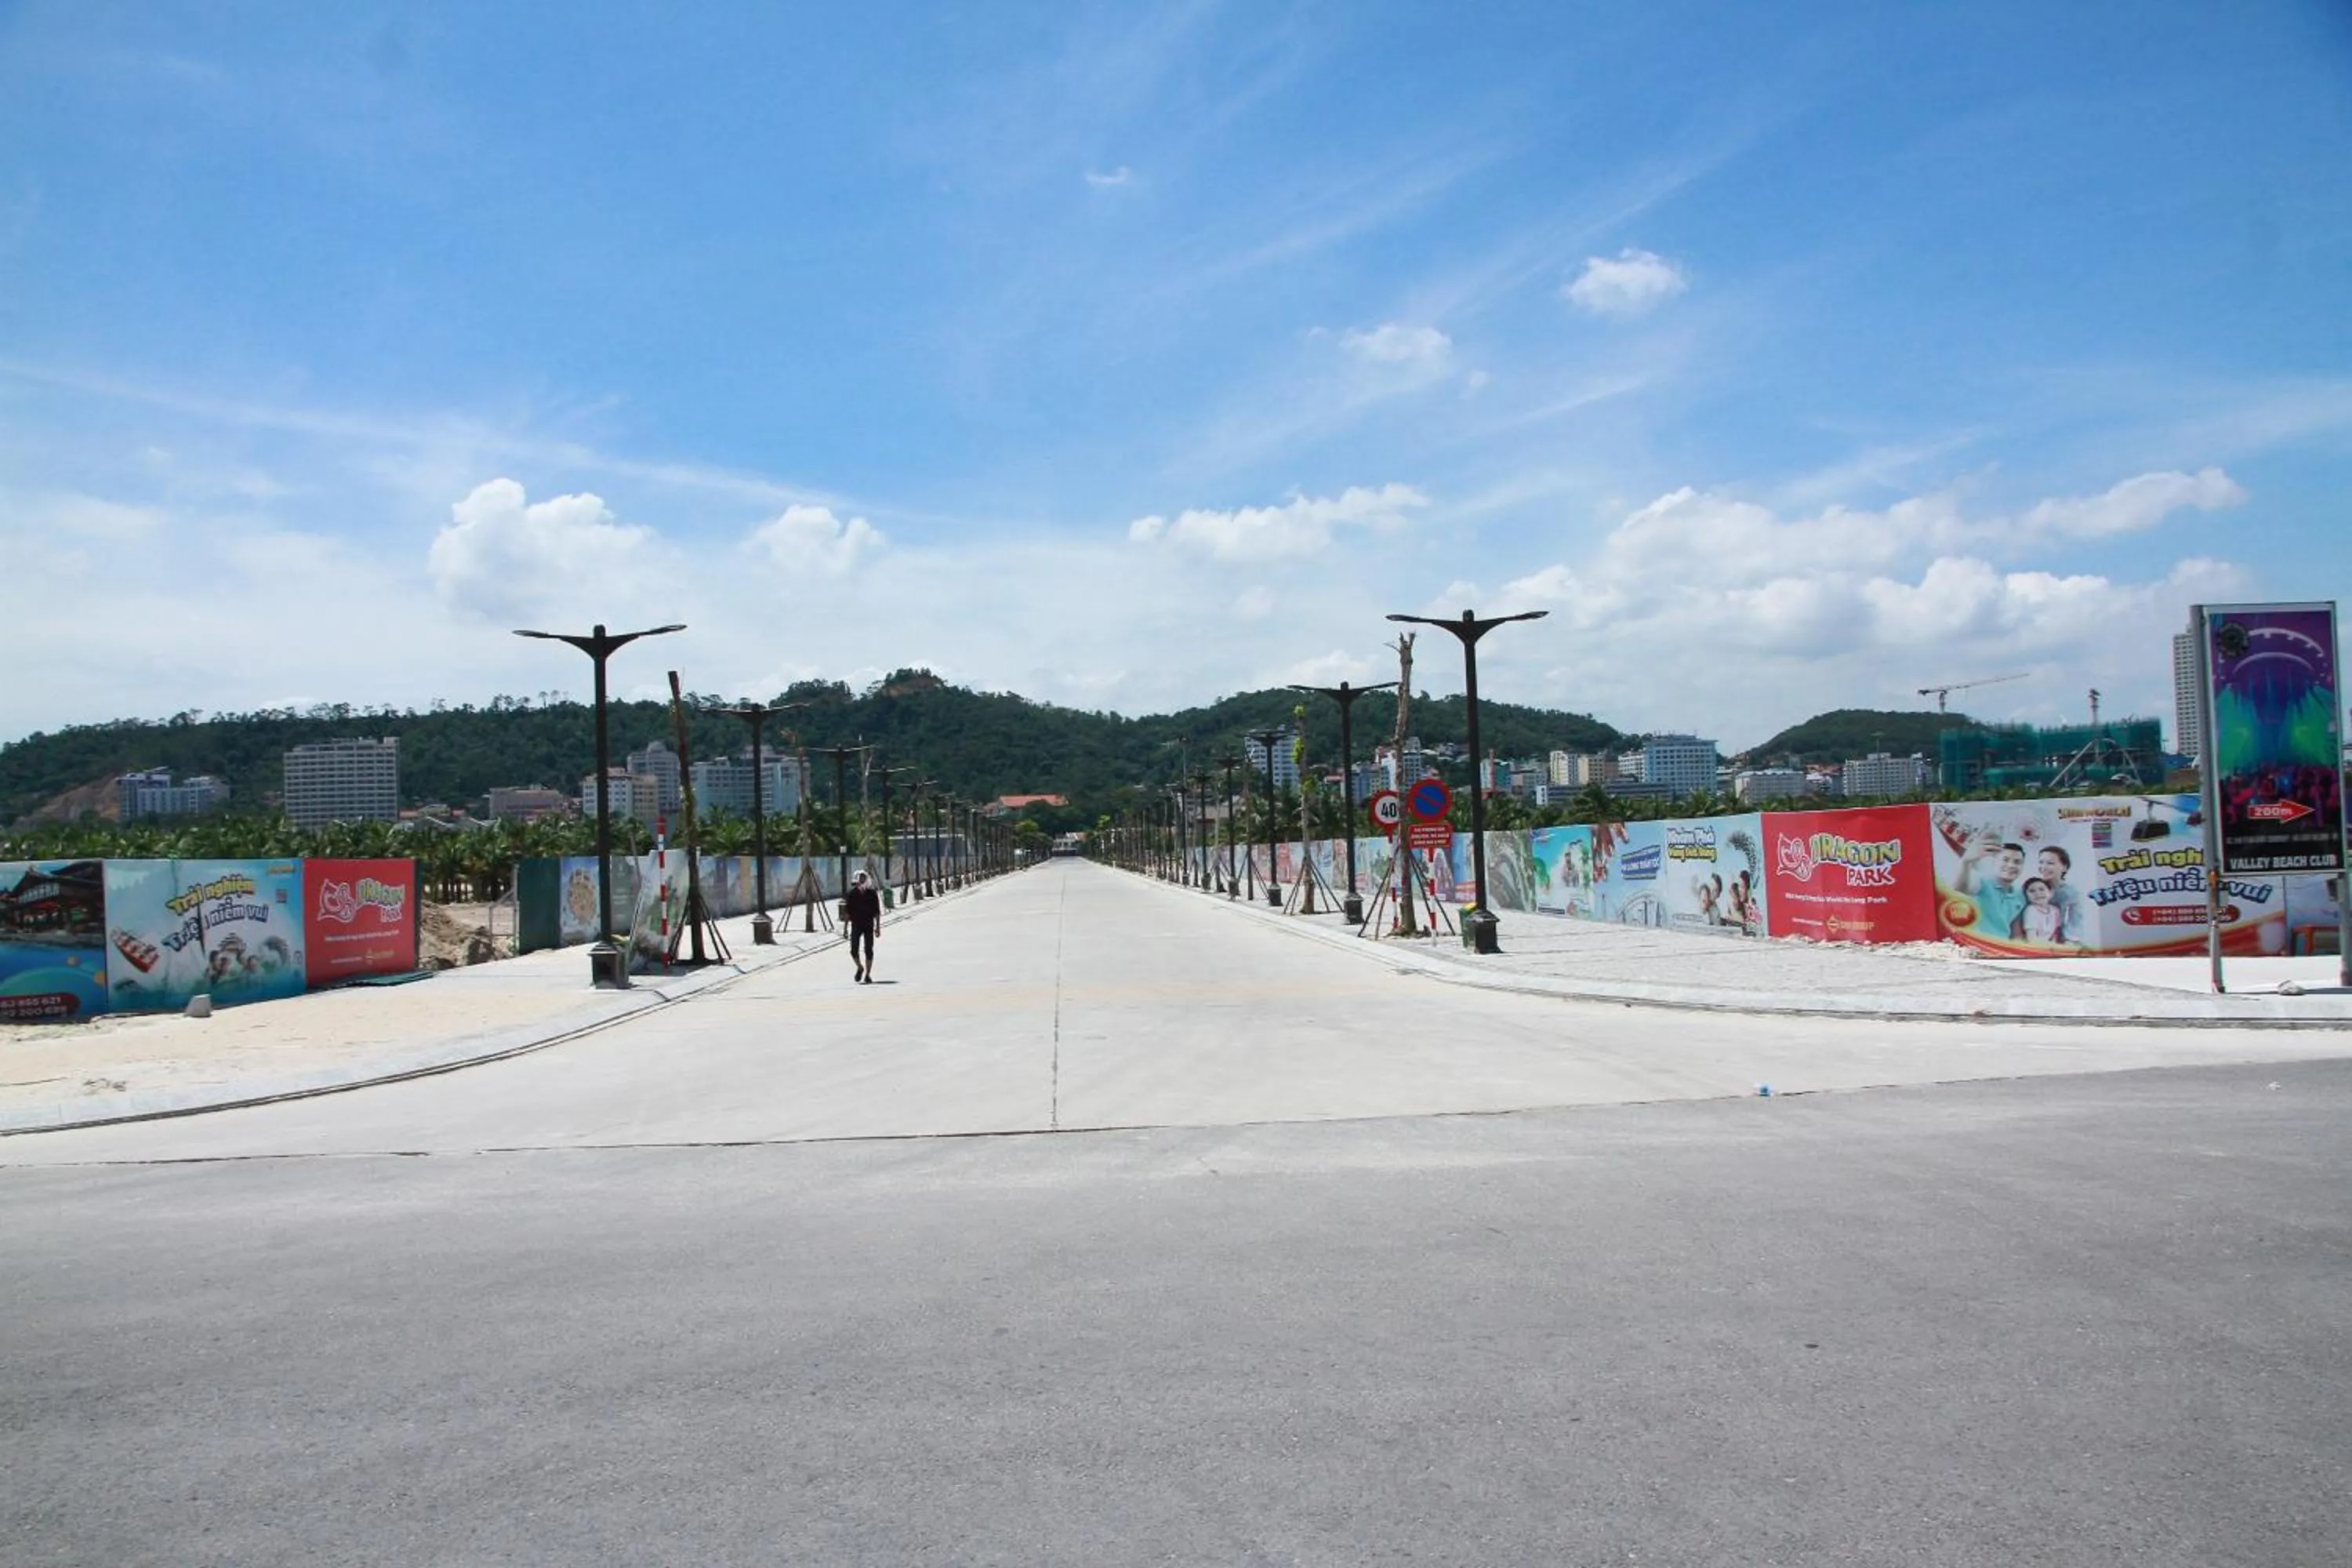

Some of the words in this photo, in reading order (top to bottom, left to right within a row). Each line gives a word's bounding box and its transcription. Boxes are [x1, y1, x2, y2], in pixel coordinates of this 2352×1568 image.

[1381, 802, 1397, 818] 40
[2254, 807, 2293, 817] 200m
[1809, 833, 1901, 868] DRAGON
[2098, 848, 2151, 875] Trải
[2154, 847, 2205, 868] ngh
[2230, 857, 2271, 870] VALLEY
[2272, 855, 2307, 869] BEACH
[2309, 853, 2337, 866] CLUB
[1847, 864, 1895, 886] PARK
[2089, 877, 2158, 906] Triệu
[2227, 880, 2272, 904] vui
